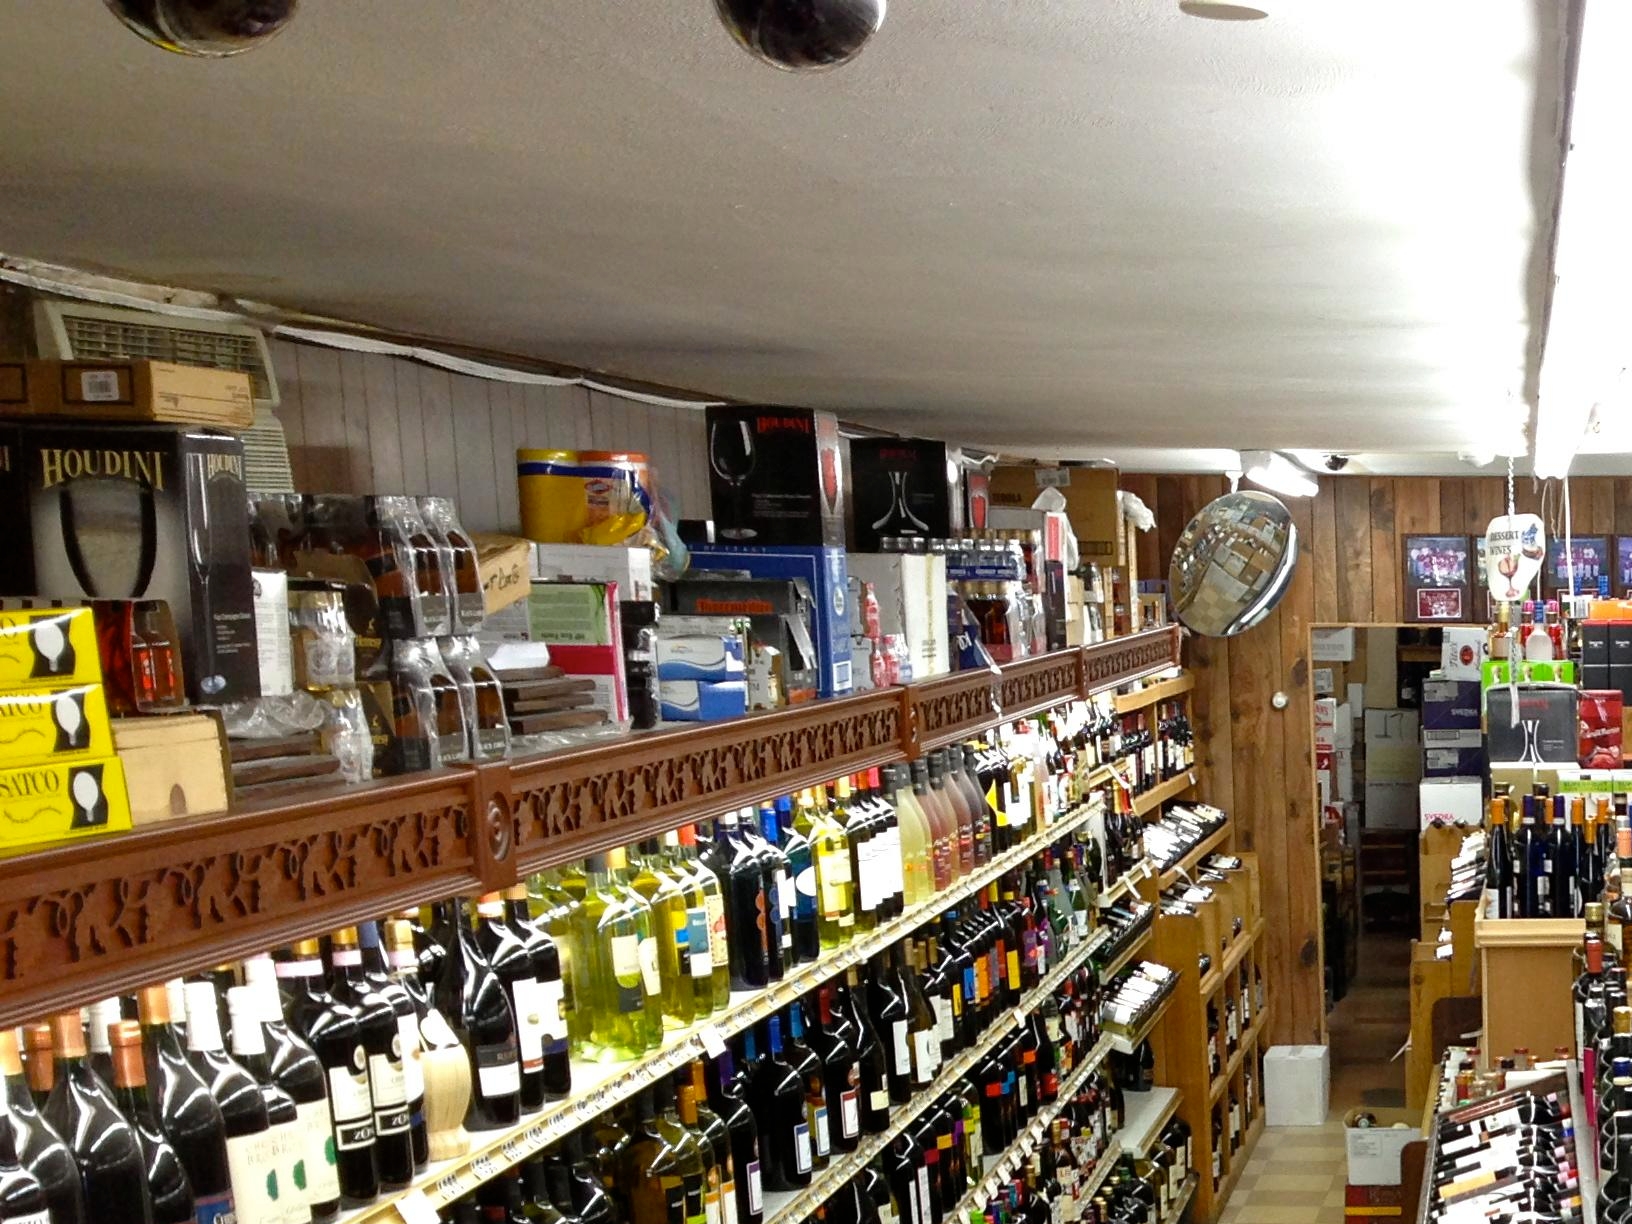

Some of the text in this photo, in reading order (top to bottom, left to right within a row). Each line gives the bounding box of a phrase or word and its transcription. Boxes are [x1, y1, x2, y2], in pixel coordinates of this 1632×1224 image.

[40, 448, 165, 492] HOUDINI
[207, 453, 243, 481] HOUDINI
[1488, 530, 1520, 543] DESSERT
